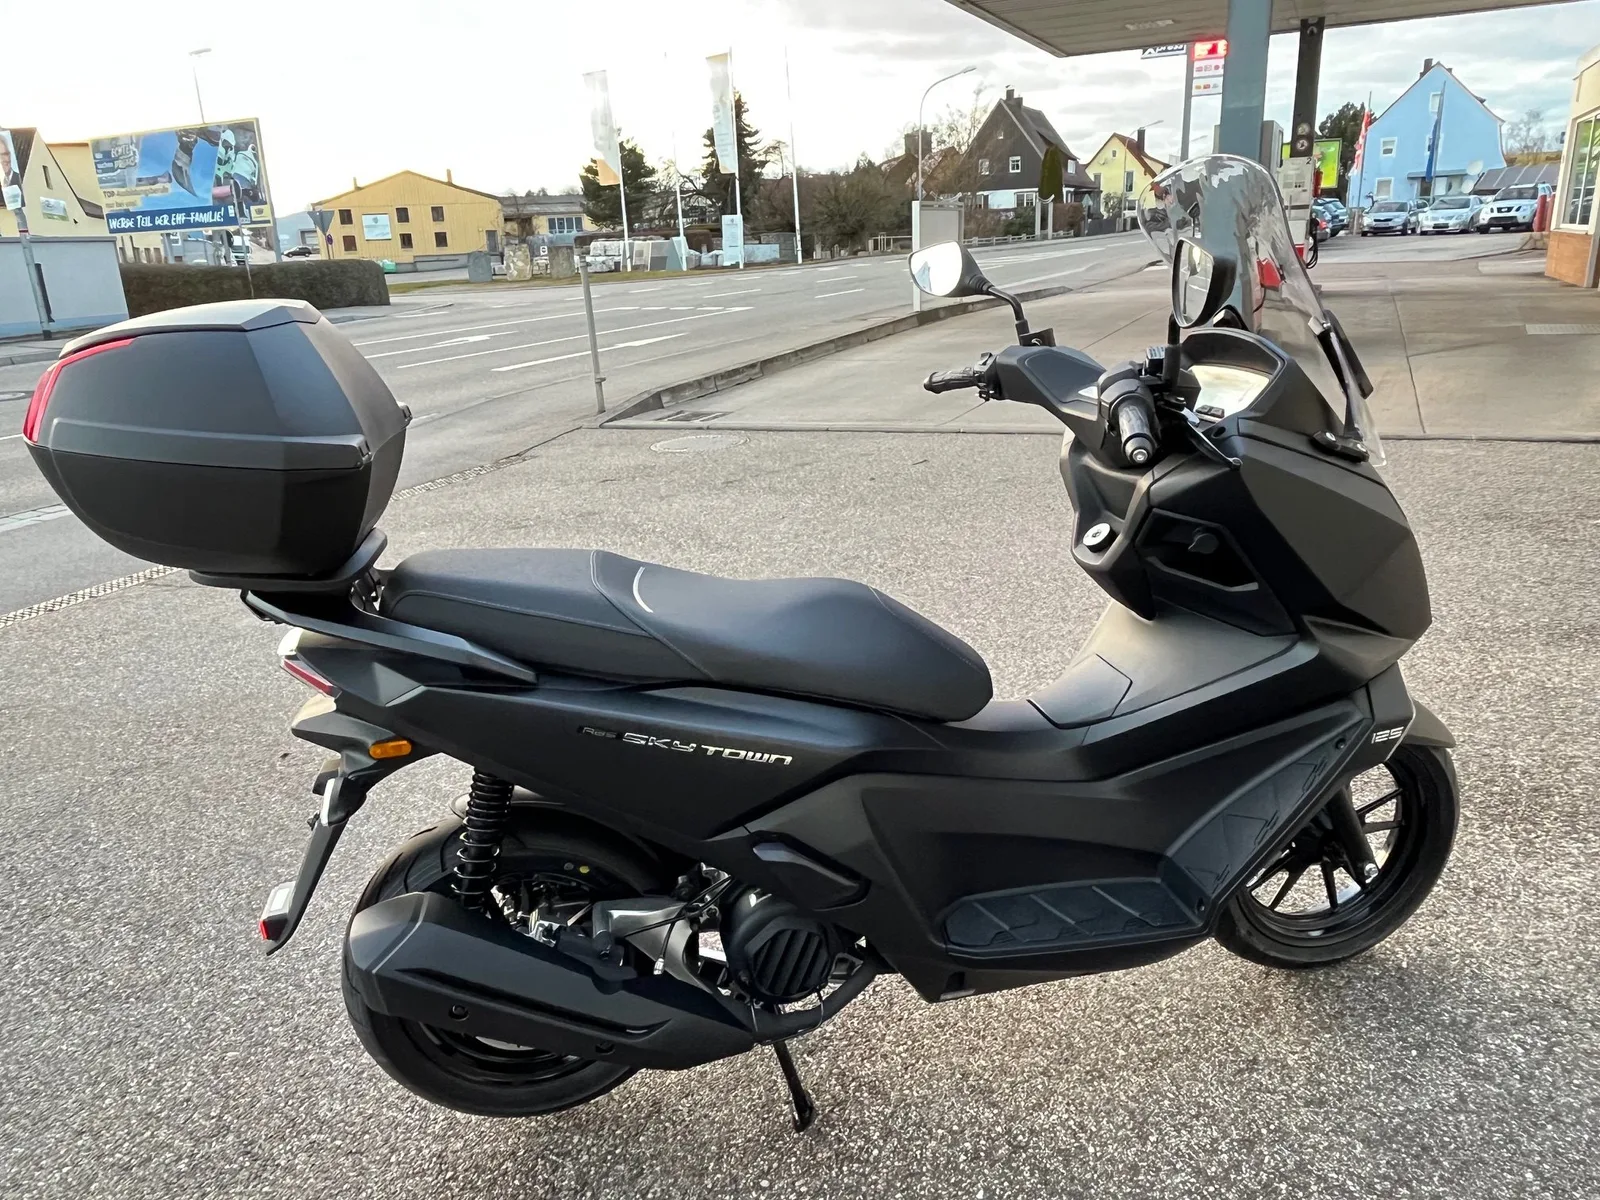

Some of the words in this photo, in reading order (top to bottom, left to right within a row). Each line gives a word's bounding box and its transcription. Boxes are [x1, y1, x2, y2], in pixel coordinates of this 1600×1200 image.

[109, 217, 135, 229] WERDE
[136, 214, 153, 228] TEIL
[155, 214, 171, 226] DER
[1371, 726, 1404, 744] 125
